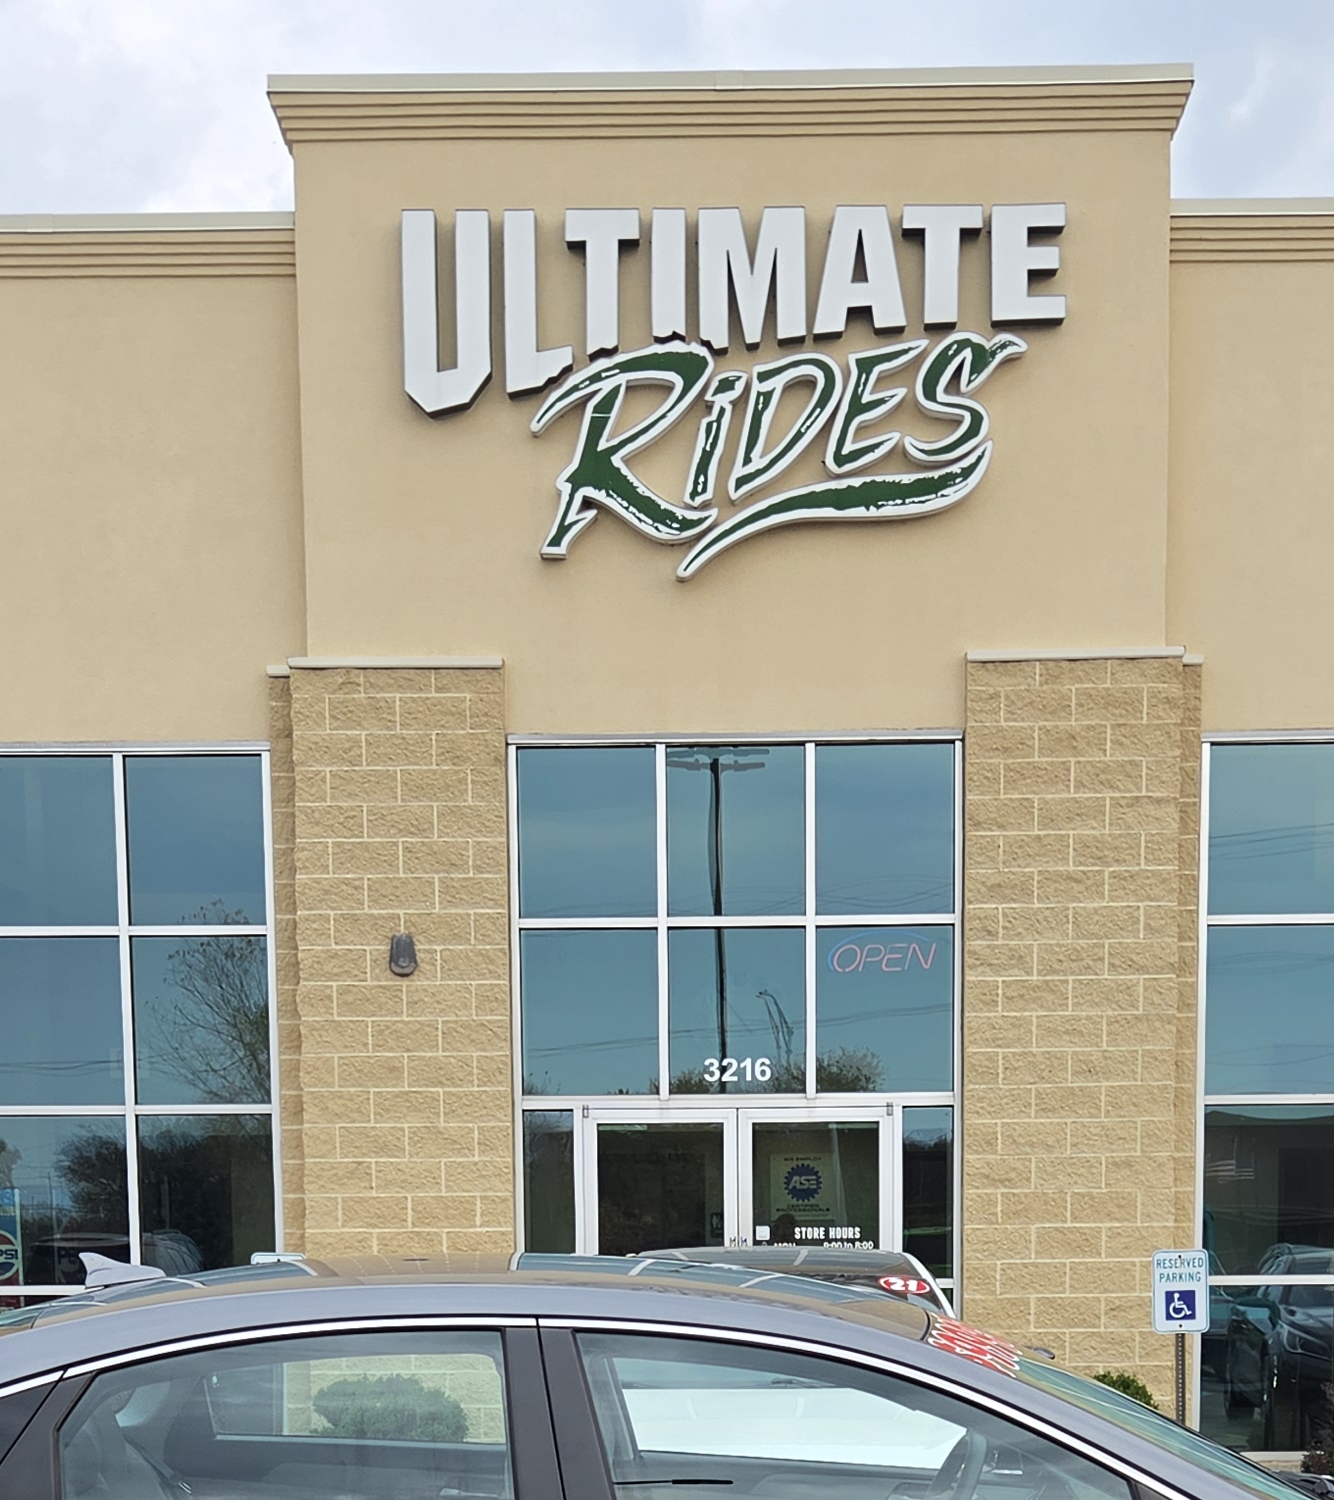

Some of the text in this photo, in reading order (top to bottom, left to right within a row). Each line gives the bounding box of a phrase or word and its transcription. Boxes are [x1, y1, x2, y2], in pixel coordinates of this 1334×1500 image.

[400, 203, 1067, 421] ULTIMATE
[833, 942, 937, 973] OPEN
[703, 1057, 772, 1082] 3216
[788, 1176, 817, 1190] ASE
[794, 1226, 861, 1240] STORE HOURS
[1156, 1257, 1204, 1269] RESERVED
[888, 1277, 918, 1291] 21
[1159, 1271, 1202, 1283] PARKING
